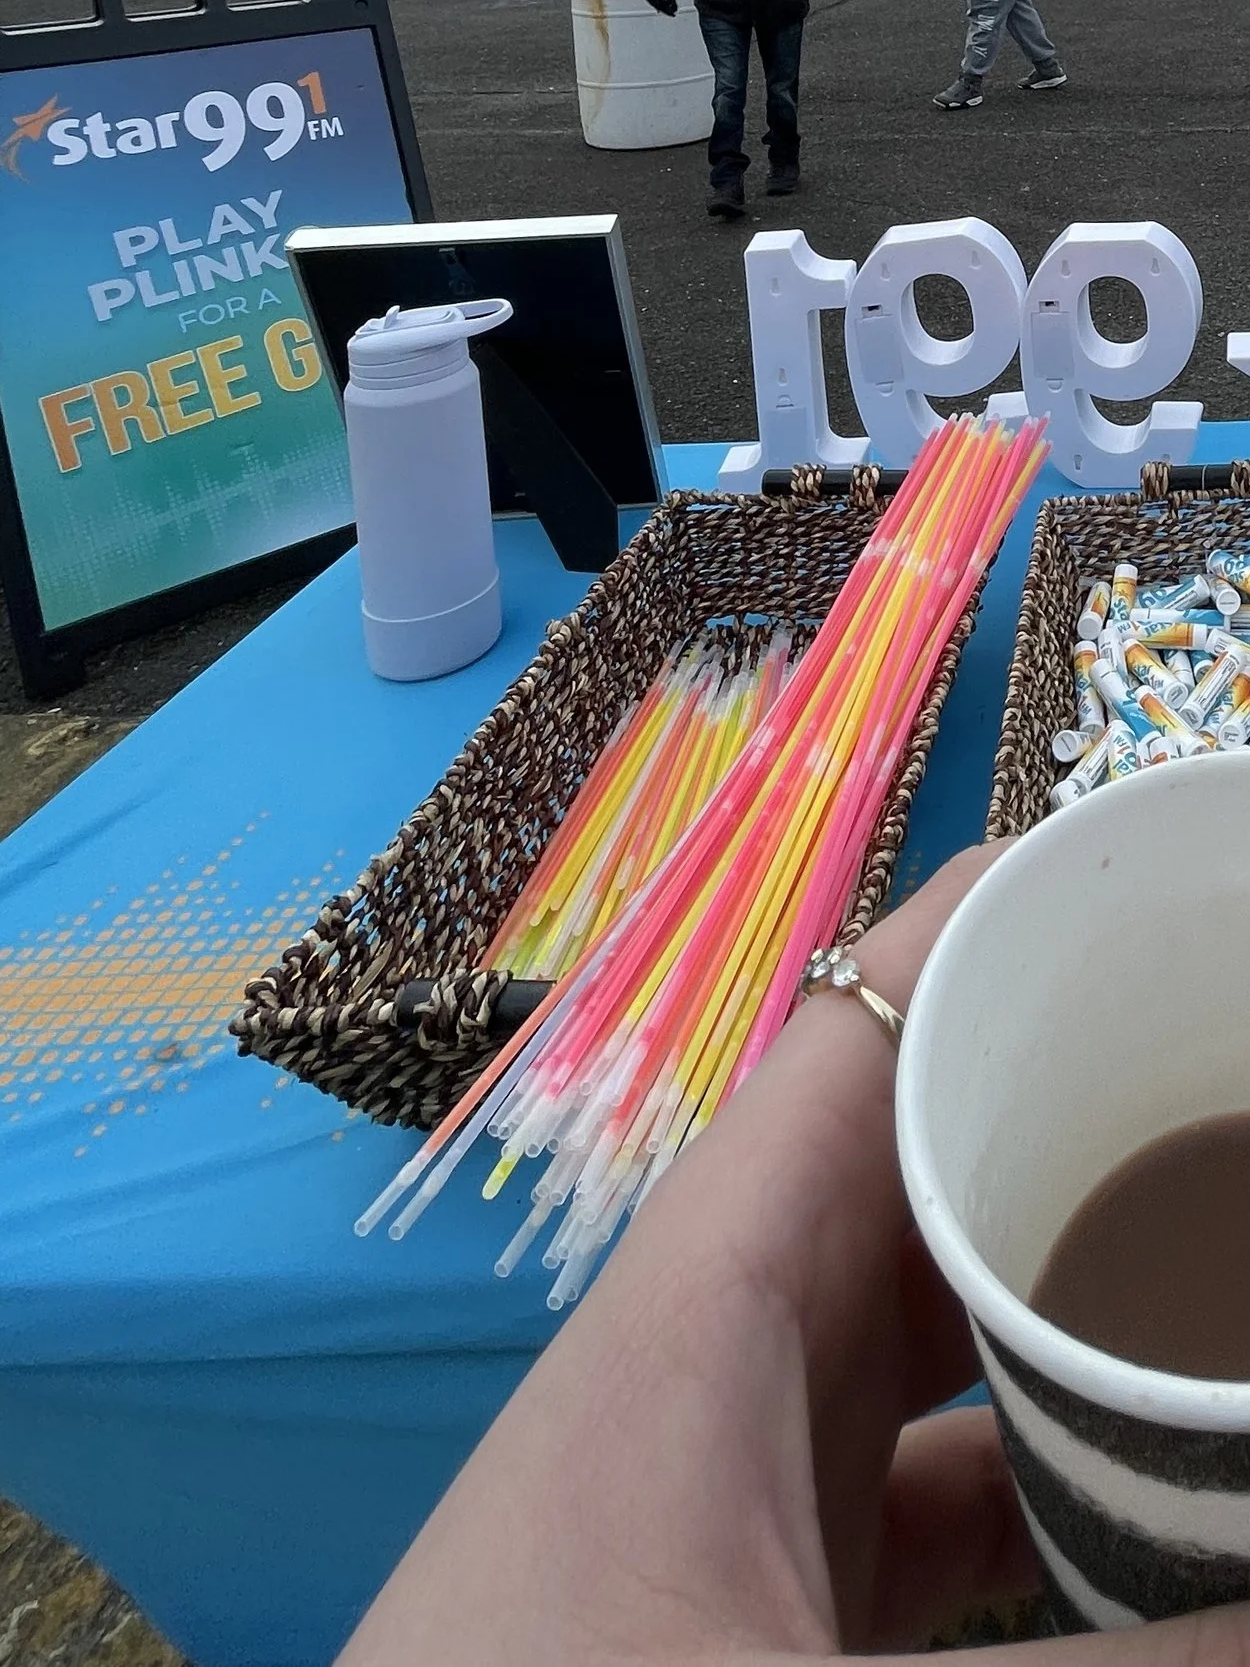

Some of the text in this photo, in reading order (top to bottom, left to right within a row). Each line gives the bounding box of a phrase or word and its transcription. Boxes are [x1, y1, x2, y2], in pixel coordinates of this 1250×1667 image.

[308, 116, 344, 141] FM
[113, 189, 284, 269] PLAY
[177, 288, 283, 334] FOR A
[38, 334, 262, 474] FREE
